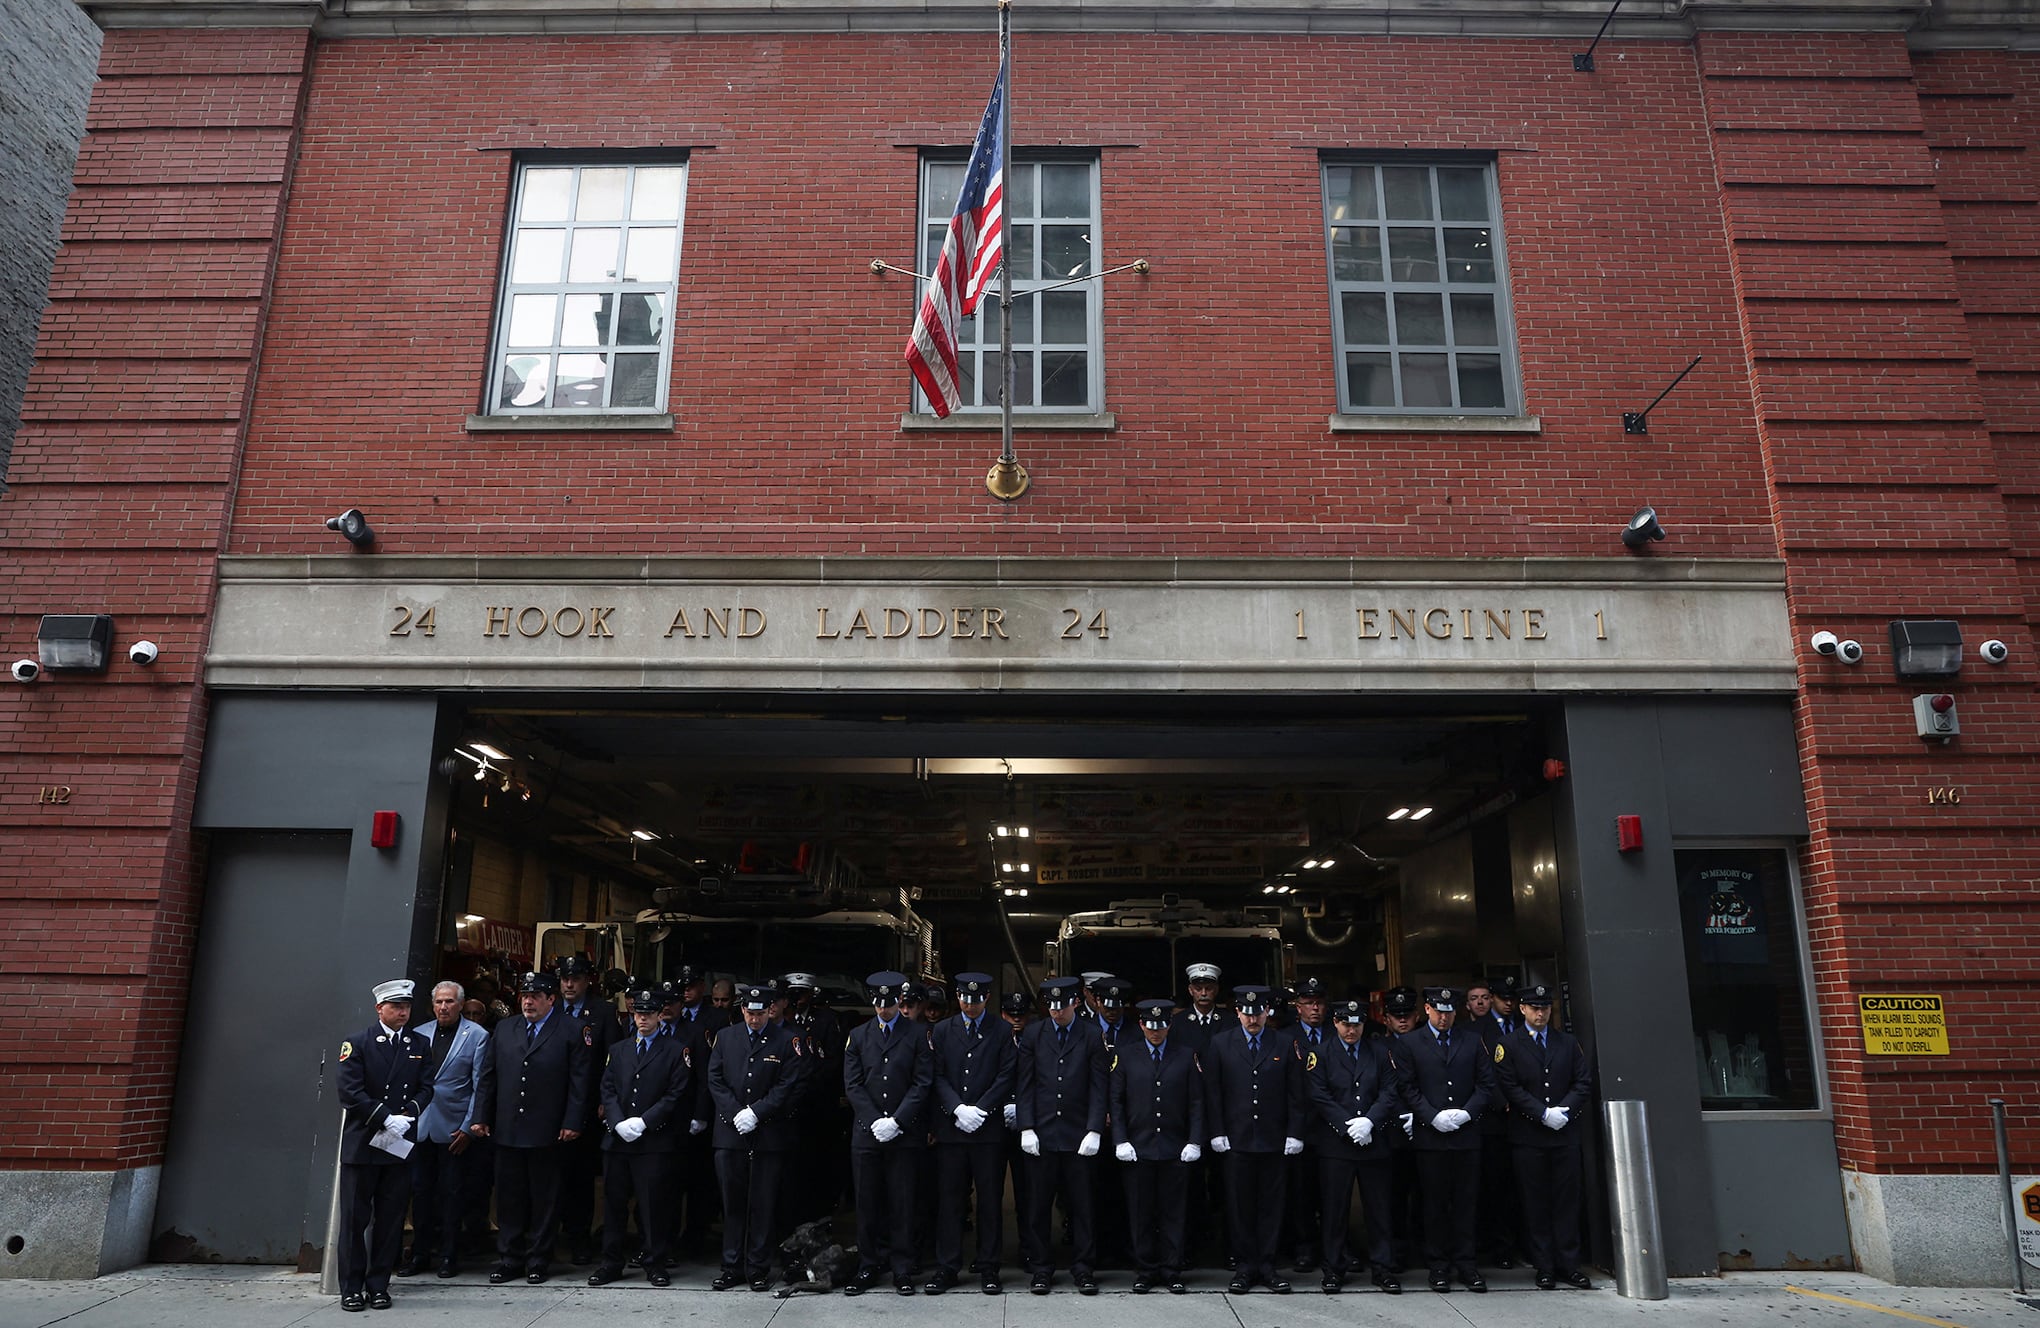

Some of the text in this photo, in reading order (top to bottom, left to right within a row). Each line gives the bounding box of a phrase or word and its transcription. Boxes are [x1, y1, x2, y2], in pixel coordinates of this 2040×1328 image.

[390, 605, 1608, 640] 24 HOOK AND LADDER 24 1 ENGINE 1
[38, 785, 72, 804] 142
[1927, 787, 1960, 805] 146
[482, 923, 525, 956] LADDER
[1865, 999, 1936, 1010] CAUTION
[1863, 1014, 1942, 1025] WHEN ALARM BELL SOUNDS
[1868, 1027, 1940, 1038] TANK FILLED TO CAPACITY
[1882, 1041, 1933, 1052] DO NOT OVERFILL
